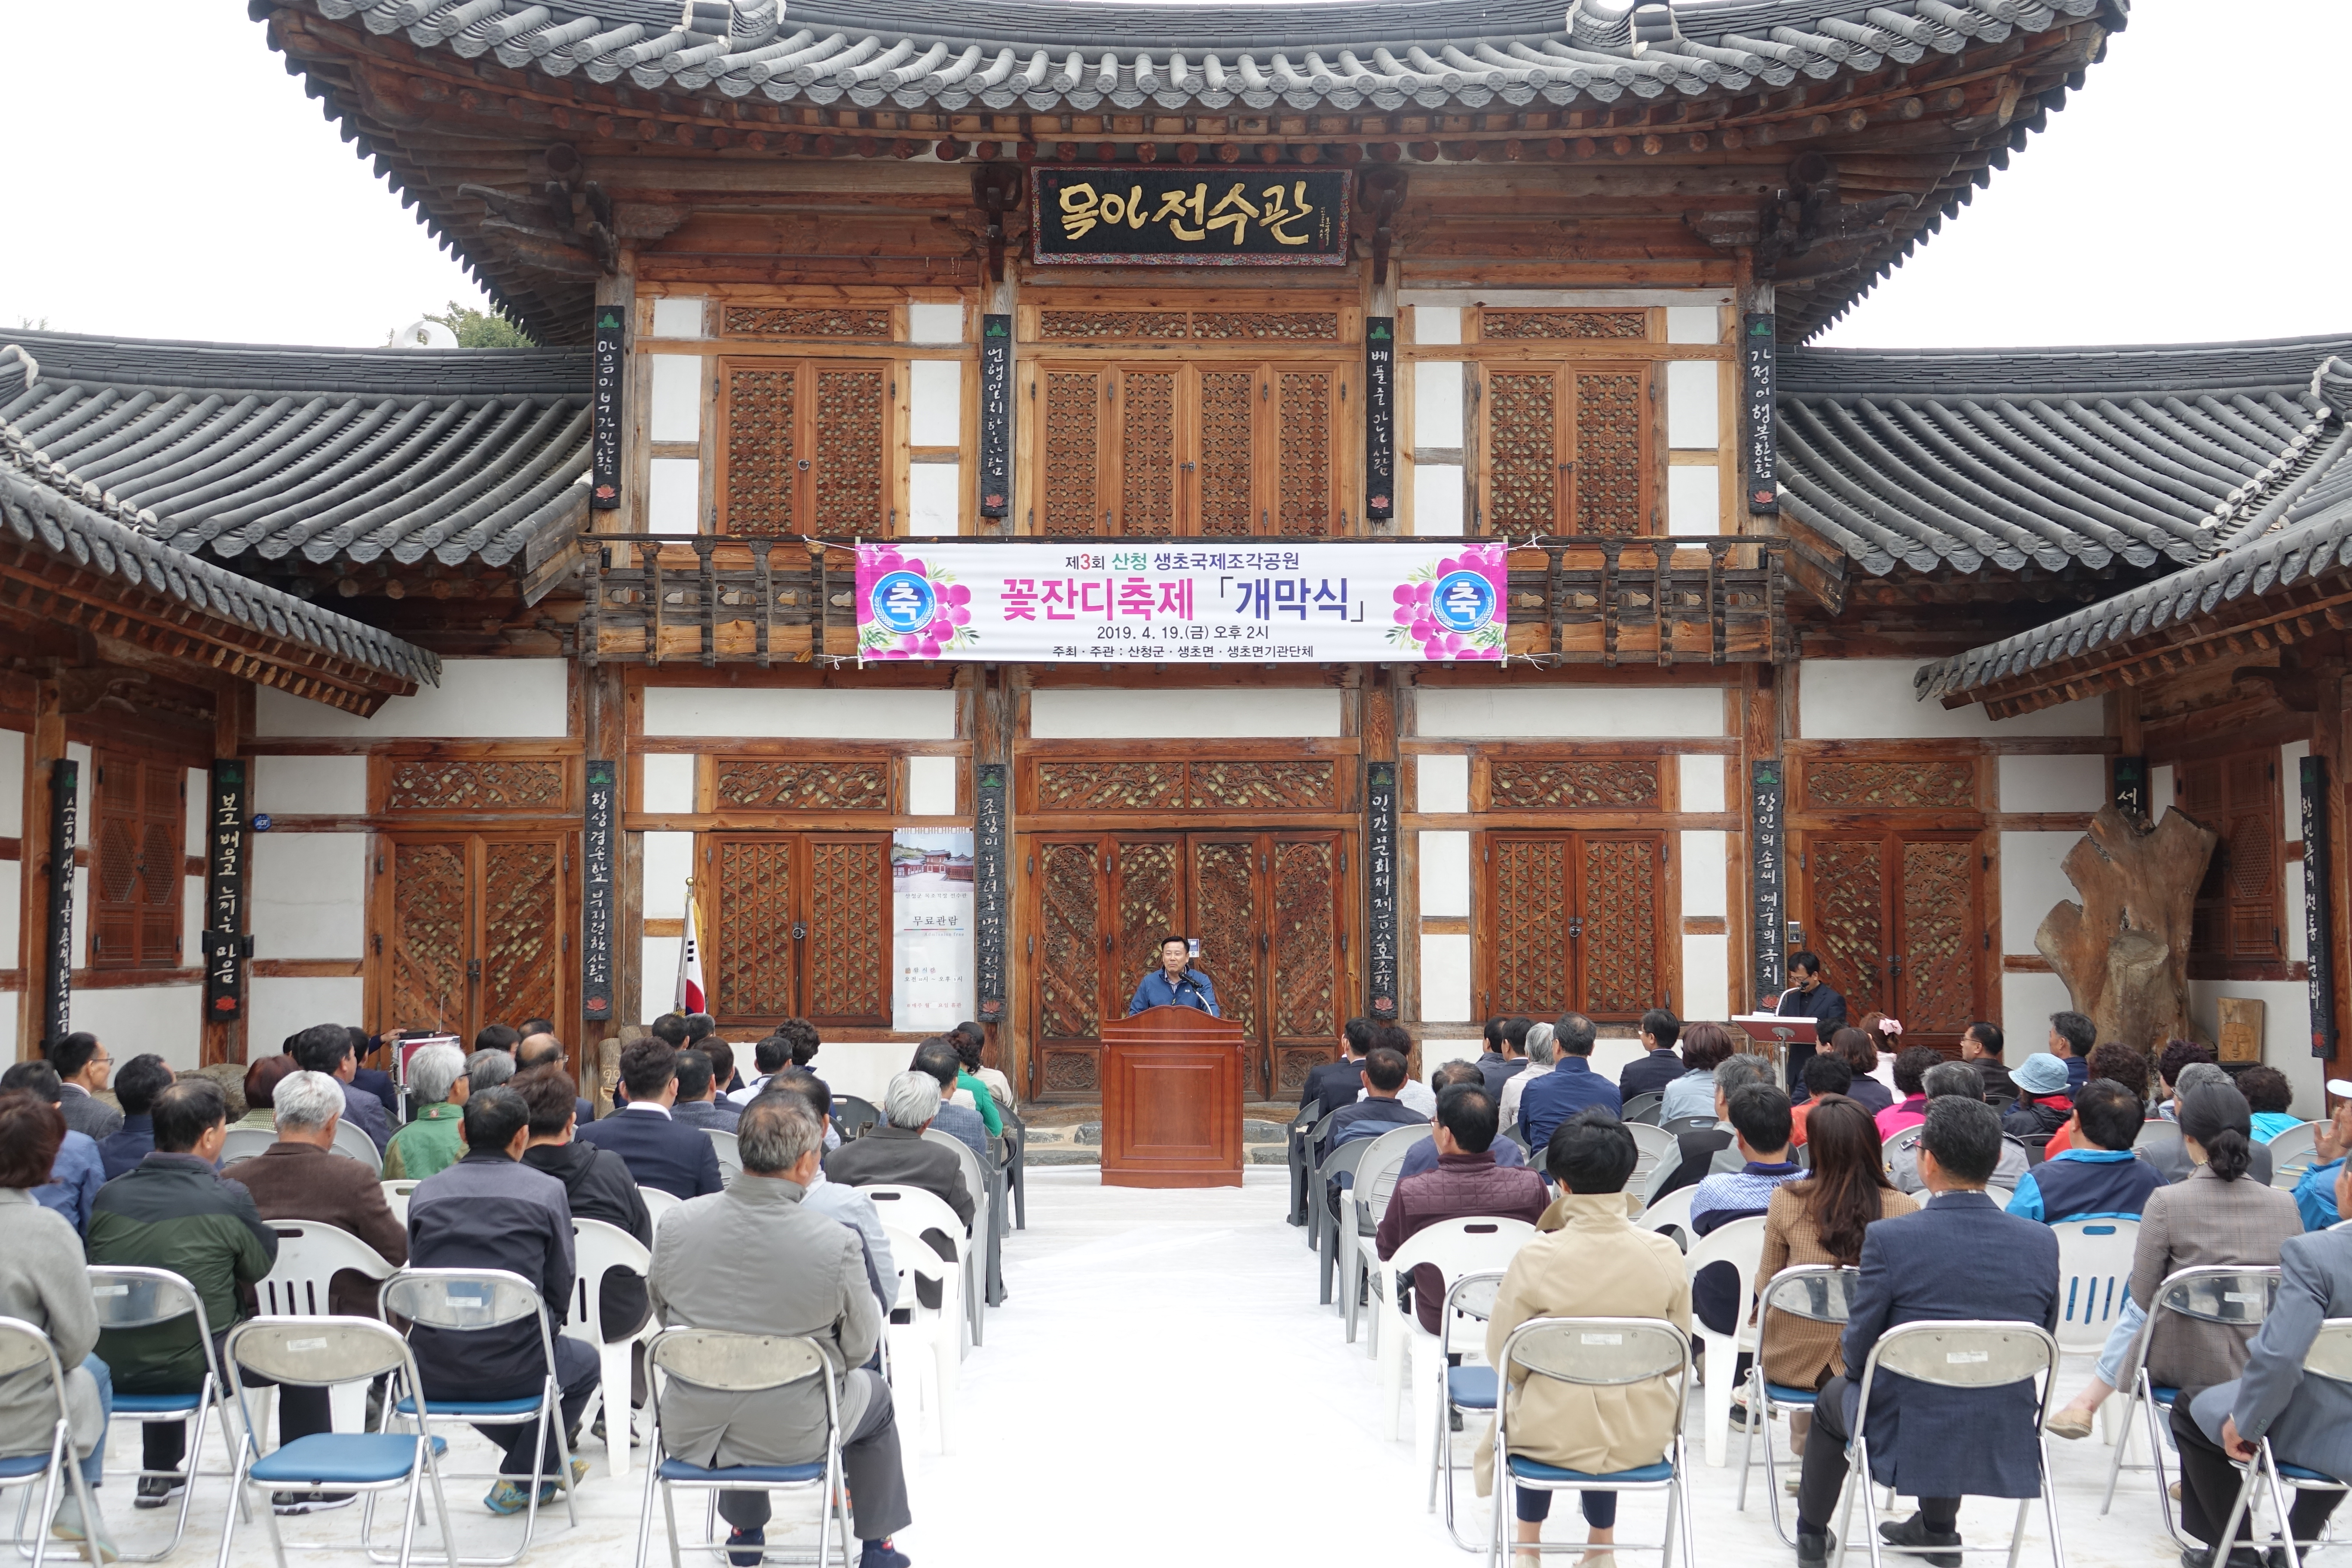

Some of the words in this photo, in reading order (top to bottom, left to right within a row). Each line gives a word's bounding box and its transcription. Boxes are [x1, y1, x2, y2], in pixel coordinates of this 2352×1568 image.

[1066, 553, 1105, 570] 제3회
[1112, 553, 1147, 571] 산청
[1154, 552, 1299, 571] 생초국제조각공원
[887, 582, 921, 620] 축
[1001, 577, 1193, 621] 꽃잔디축제
[1220, 576, 1363, 622] 「개막식」
[1447, 582, 1480, 619] 축
[1097, 626, 1136, 640] 2019.
[1213, 625, 1242, 640] 오후
[1246, 625, 1268, 640] 2시
[1052, 646, 1077, 658] 주최
[1127, 646, 1165, 658] 산청군
[1177, 646, 1213, 658] 생초면
[1227, 645, 1313, 658] 생초면기관단체
[219, 793, 240, 825] 보고
[218, 830, 240, 876] 배우고
[218, 886, 236, 933] 느끼는
[913, 915, 958, 926] 무료관람
[214, 943, 236, 983] 마음
